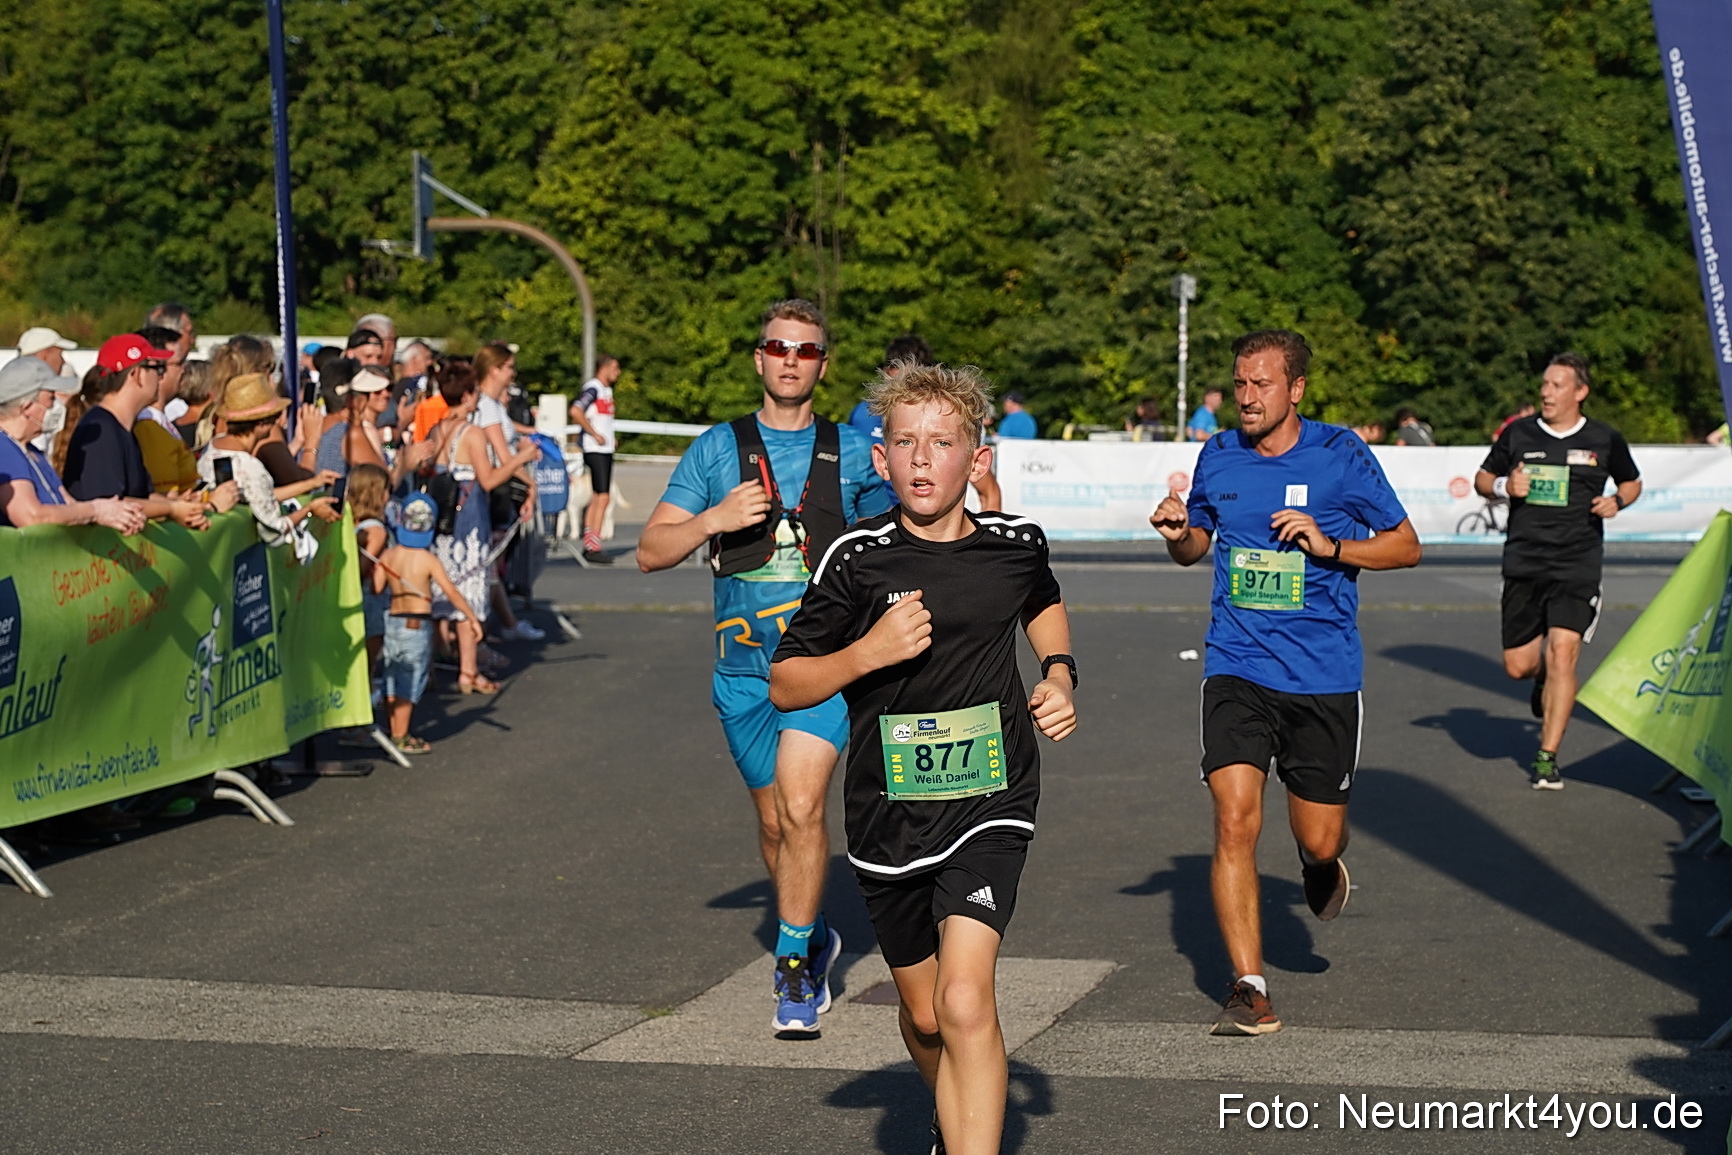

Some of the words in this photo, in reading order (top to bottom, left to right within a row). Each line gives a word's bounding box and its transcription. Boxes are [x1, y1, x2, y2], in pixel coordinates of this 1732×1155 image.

[1219, 493, 1238, 501] JAKO
[1245, 569, 1281, 590] 971
[886, 590, 916, 604] JAK
[1258, 591, 1289, 600] Stephan
[1292, 575, 1301, 602] 2022
[913, 727, 951, 738] Firmenlauf
[915, 739, 975, 772] 877
[987, 738, 1001, 779] 2022
[891, 754, 905, 783] RUN
[914, 774, 943, 784] Weiß
[946, 769, 980, 783] Daniel
[966, 894, 997, 911] adidas
